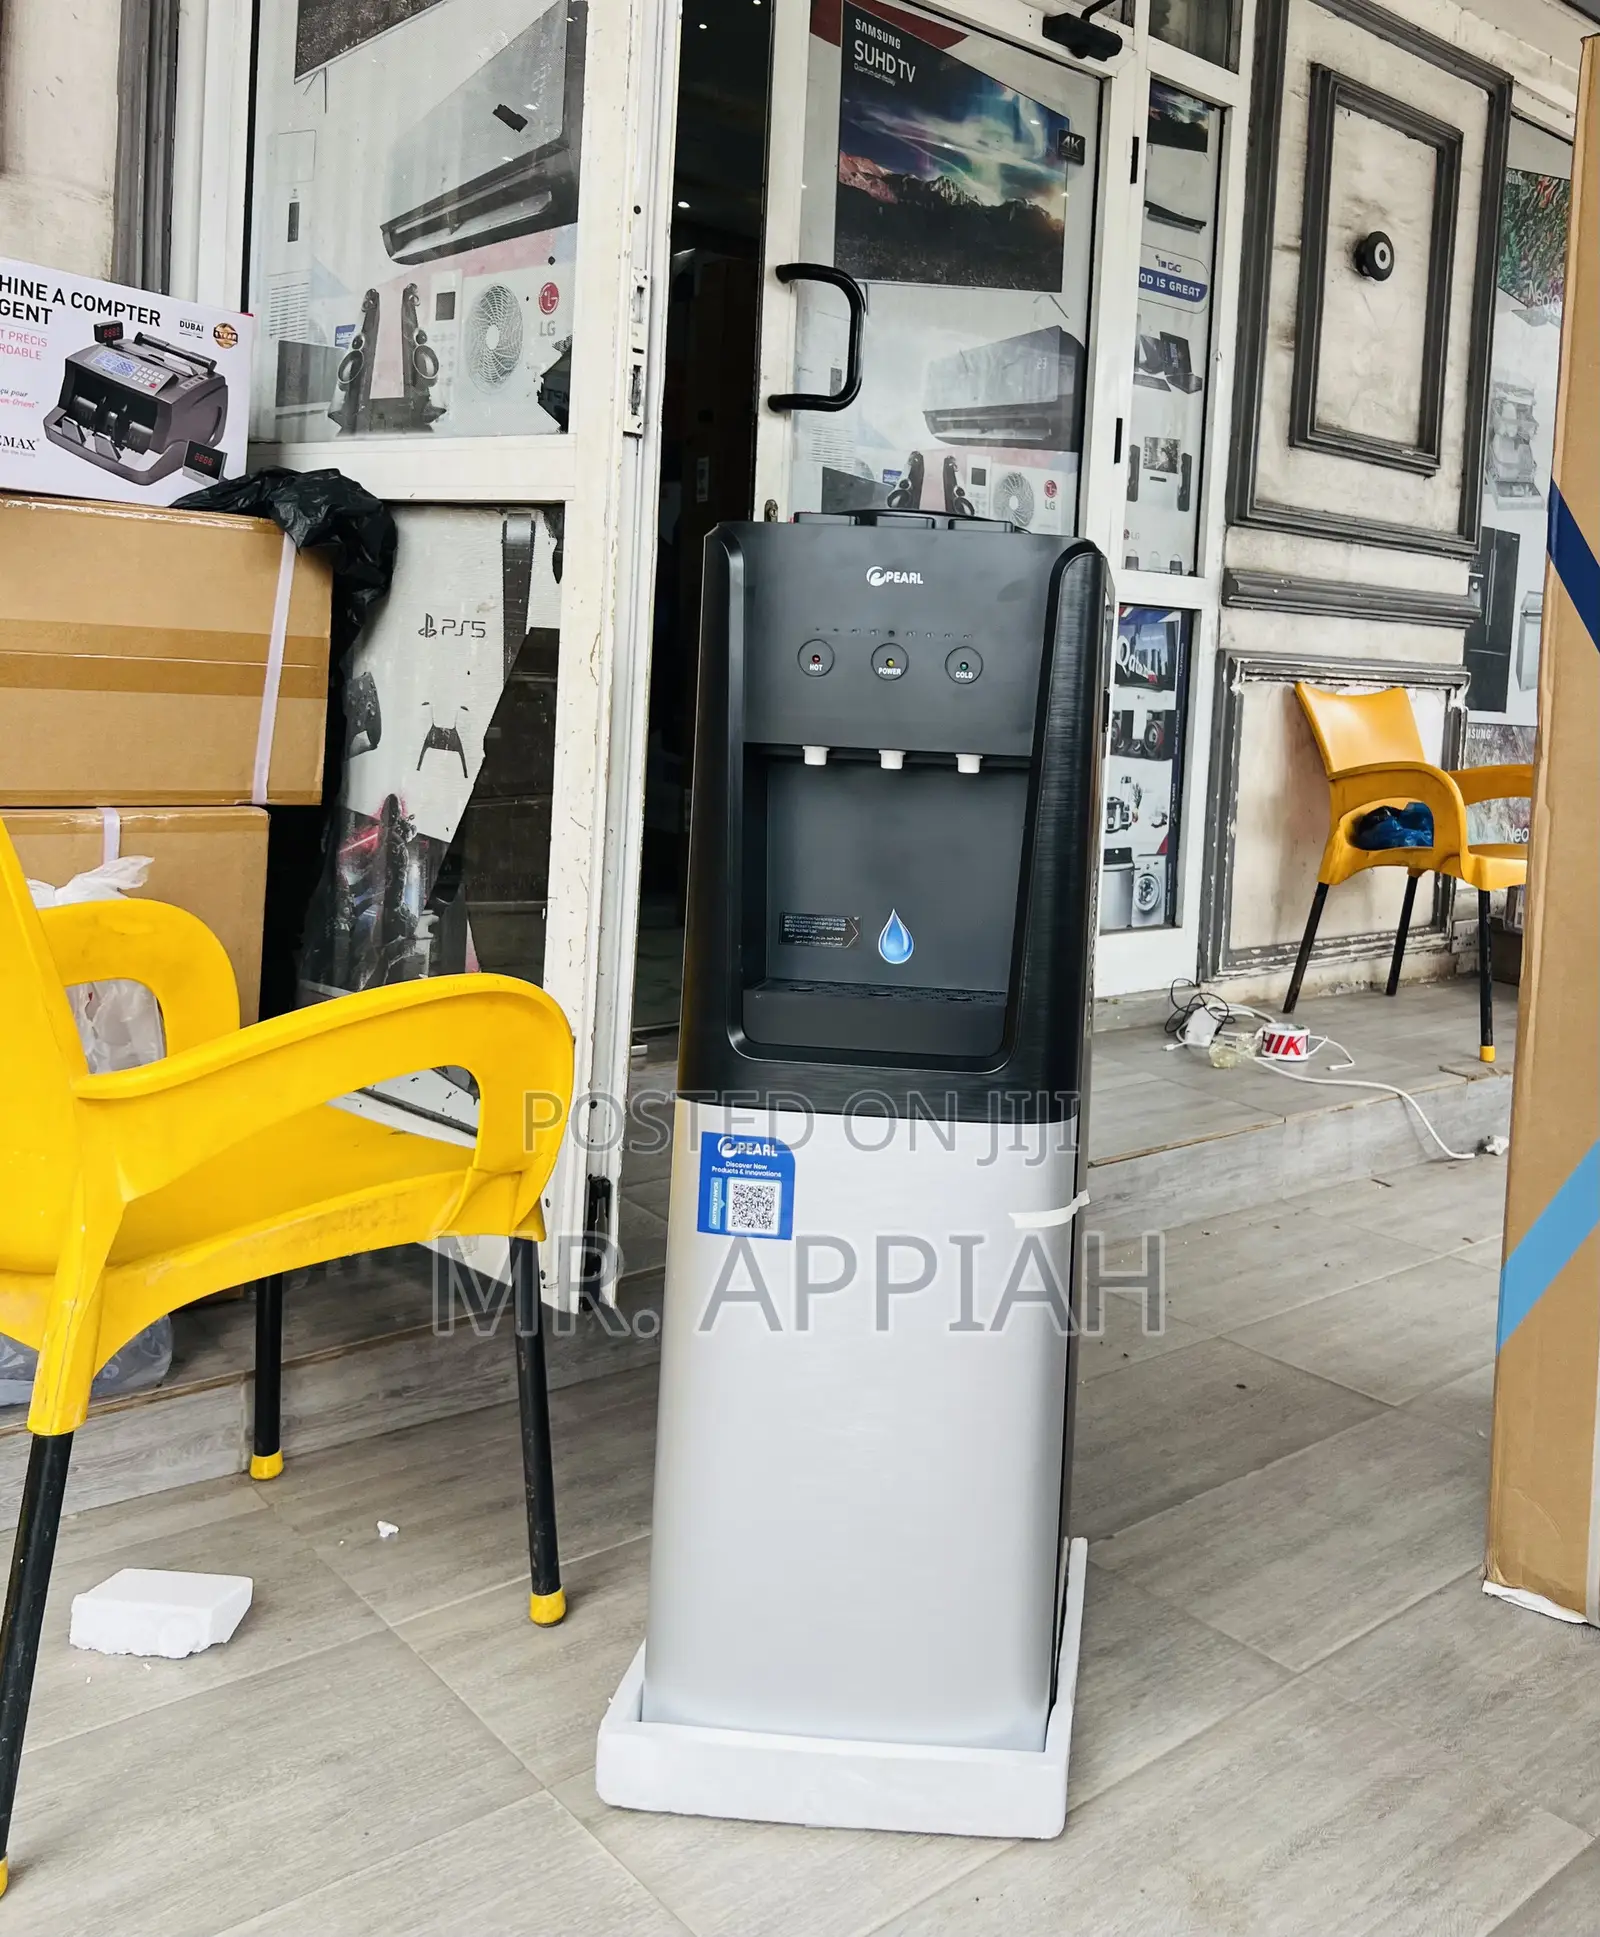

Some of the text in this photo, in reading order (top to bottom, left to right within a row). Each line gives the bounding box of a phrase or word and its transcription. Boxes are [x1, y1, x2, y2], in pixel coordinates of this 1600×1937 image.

[855, 18, 901, 50] SAMSUNG
[854, 39, 916, 83] SUHD TV
[1061, 134, 1081, 150] 4K
[1156, 276, 1166, 289] IS
[1169, 281, 1201, 298] GREAT
[0, 274, 161, 327] HINE A COMPTER
[0, 298, 53, 325] GENT
[179, 320, 205, 333] DUBAI
[540, 319, 556, 337] LG
[8, 330, 48, 348] PRÉCIS
[0, 434, 36, 451] MAX
[1044, 499, 1056, 511] LG
[885, 570, 924, 585] PEARL
[441, 618, 487, 639] PS5
[809, 663, 824, 672] HOT
[878, 667, 902, 676] POWER
[955, 671, 974, 680] COLD
[1468, 728, 1492, 741] SUNG
[1505, 823, 1530, 843] Neo
[737, 1141, 778, 1158] PEARL
[711, 1165, 739, 1175] Products
[744, 1169, 782, 1178] Innovations
[725, 1160, 768, 1171] Discover Now
